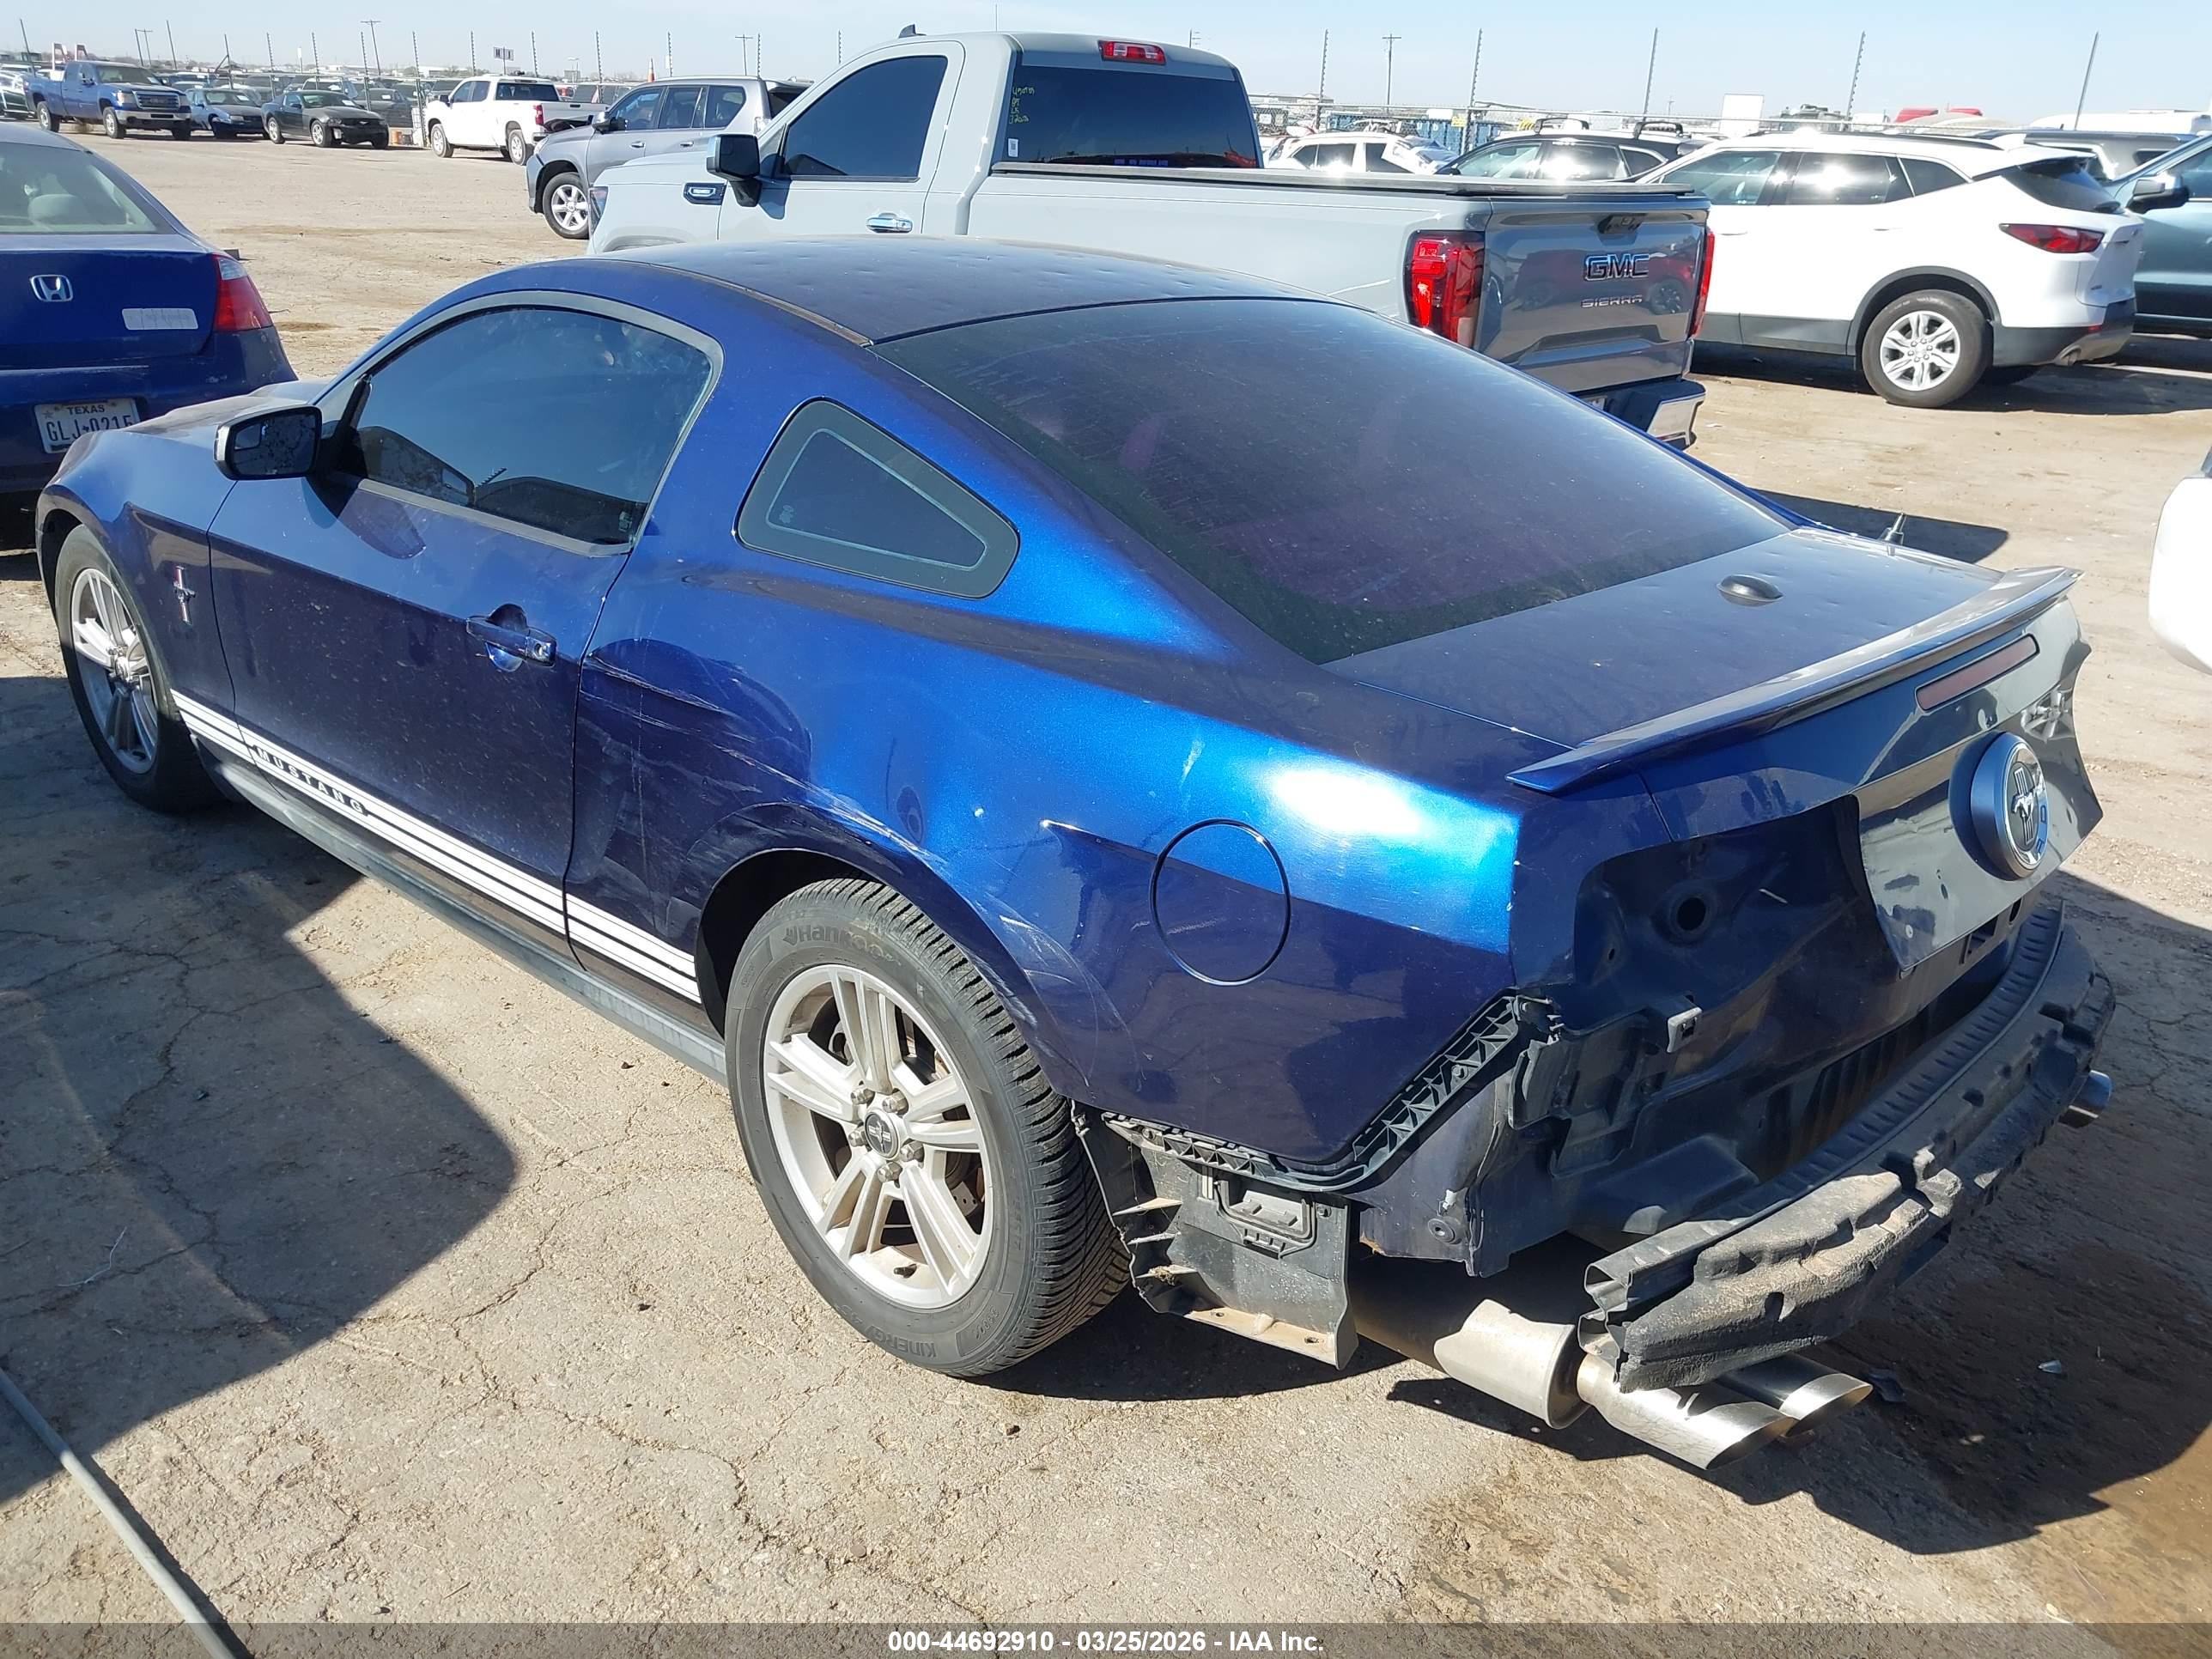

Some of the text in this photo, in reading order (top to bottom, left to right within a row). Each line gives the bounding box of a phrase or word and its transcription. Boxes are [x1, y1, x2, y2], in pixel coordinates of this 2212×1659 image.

[1585, 253, 1650, 281] GMC
[1581, 295, 1643, 307] SIERRA
[68, 404, 105, 415] TEXAS
[257, 745, 364, 815] MUSTANG
